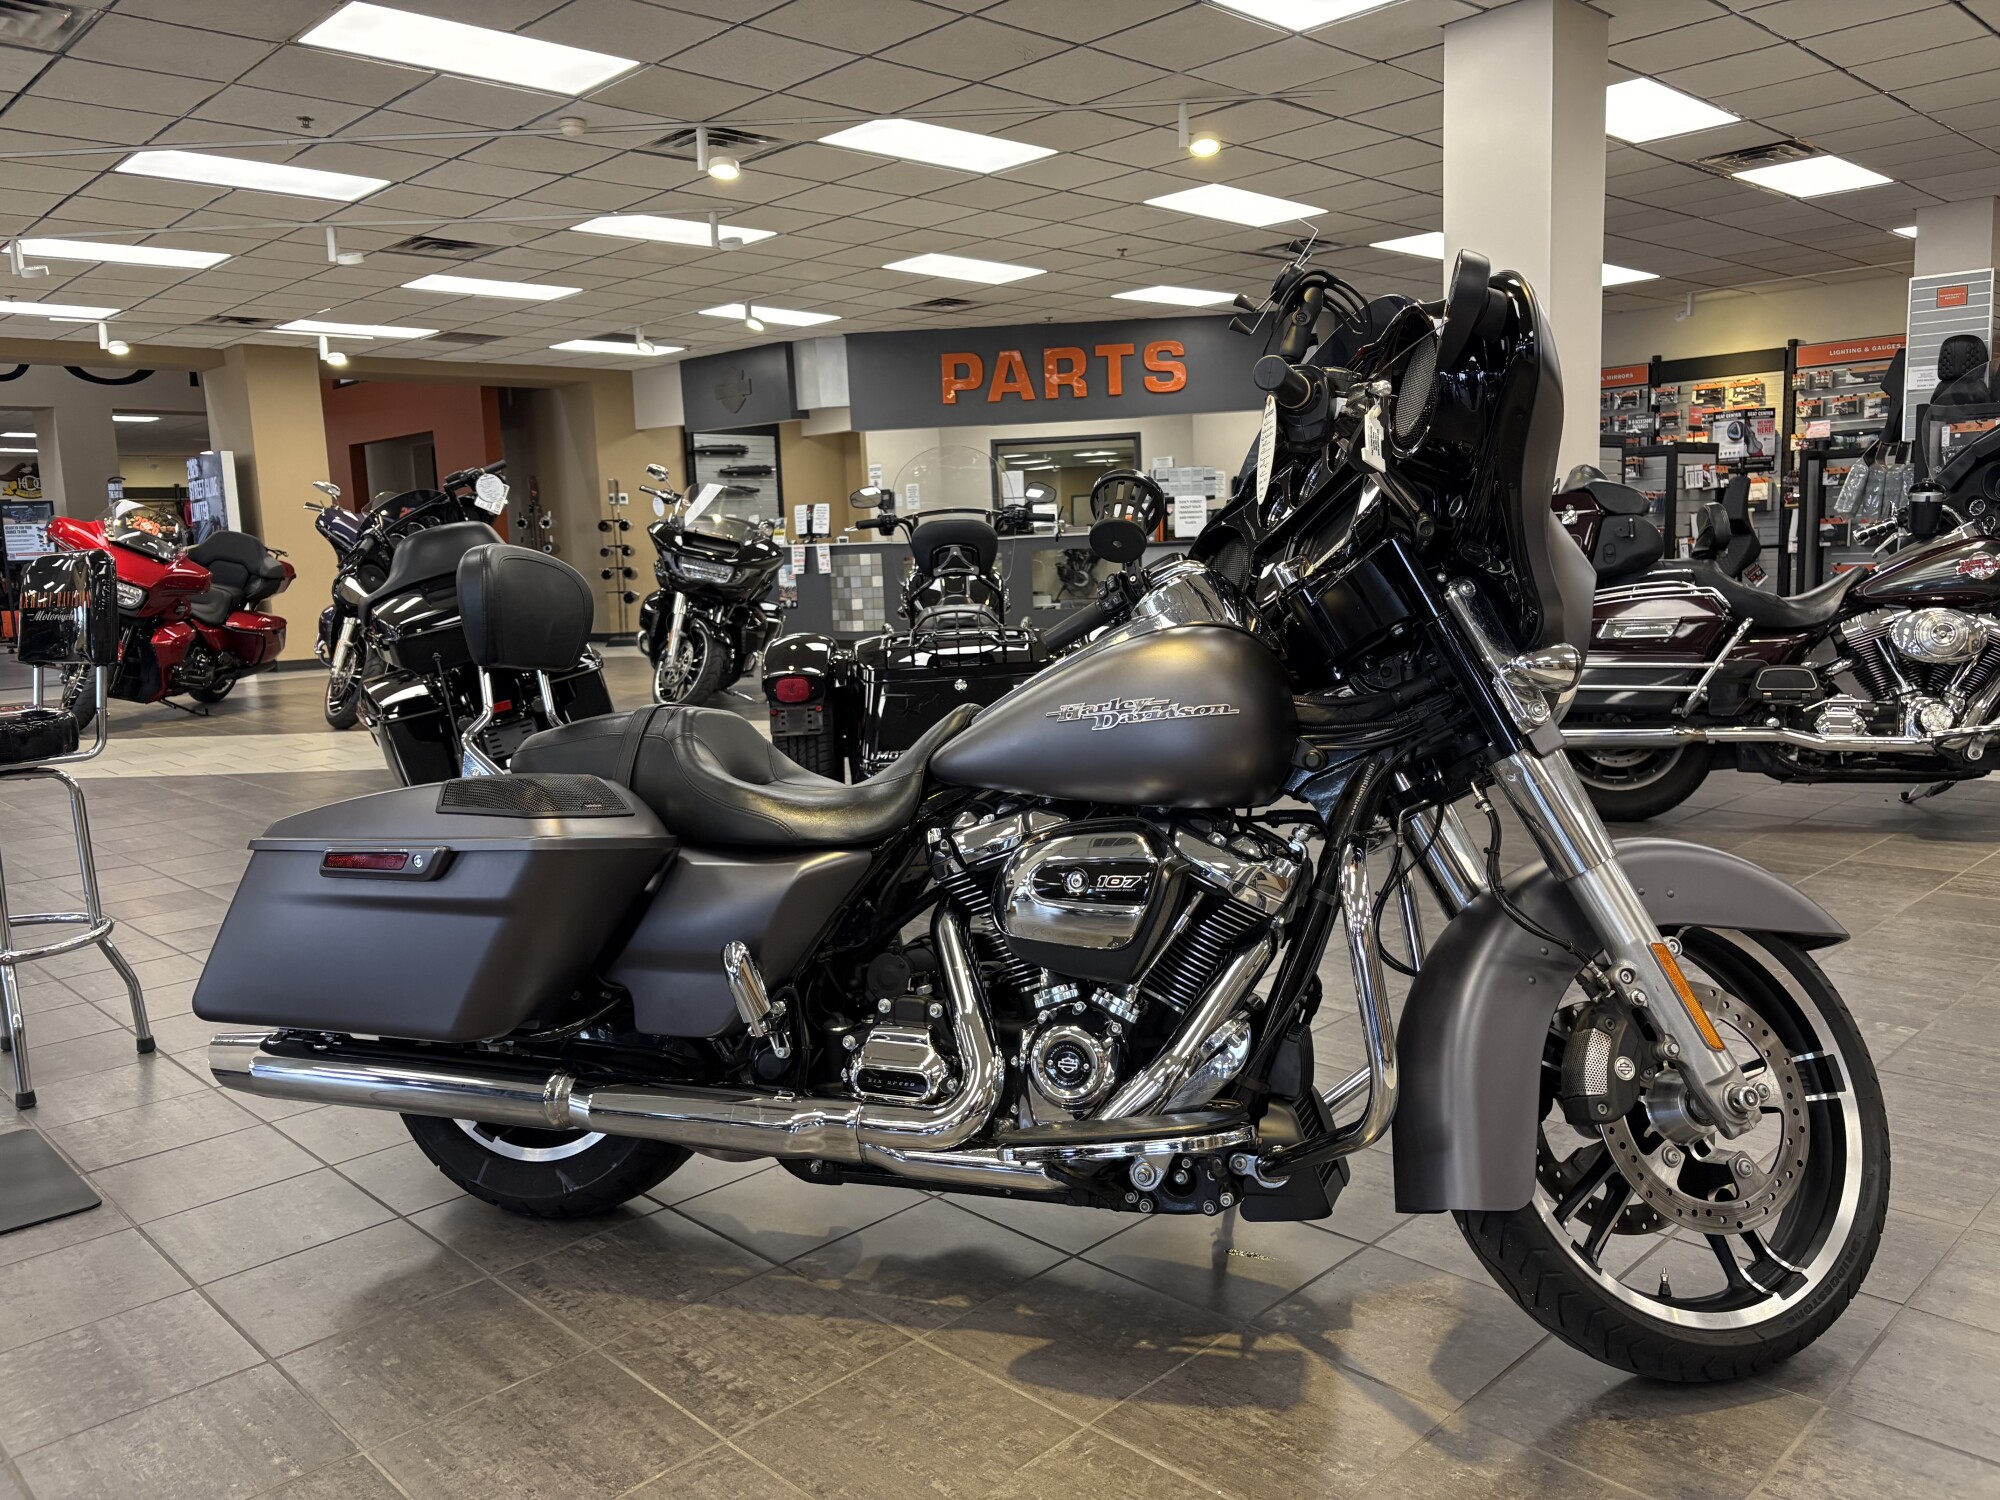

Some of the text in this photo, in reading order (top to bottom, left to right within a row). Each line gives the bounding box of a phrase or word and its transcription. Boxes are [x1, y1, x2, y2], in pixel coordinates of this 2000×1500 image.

[1829, 347, 1862, 356] LIGHTING
[1872, 344, 1901, 352] GAUGES
[941, 340, 1187, 404] PARTS
[1606, 372, 1634, 380] MIRRORS
[1082, 702, 1240, 731] Davidson
[1097, 874, 1142, 888] 107
